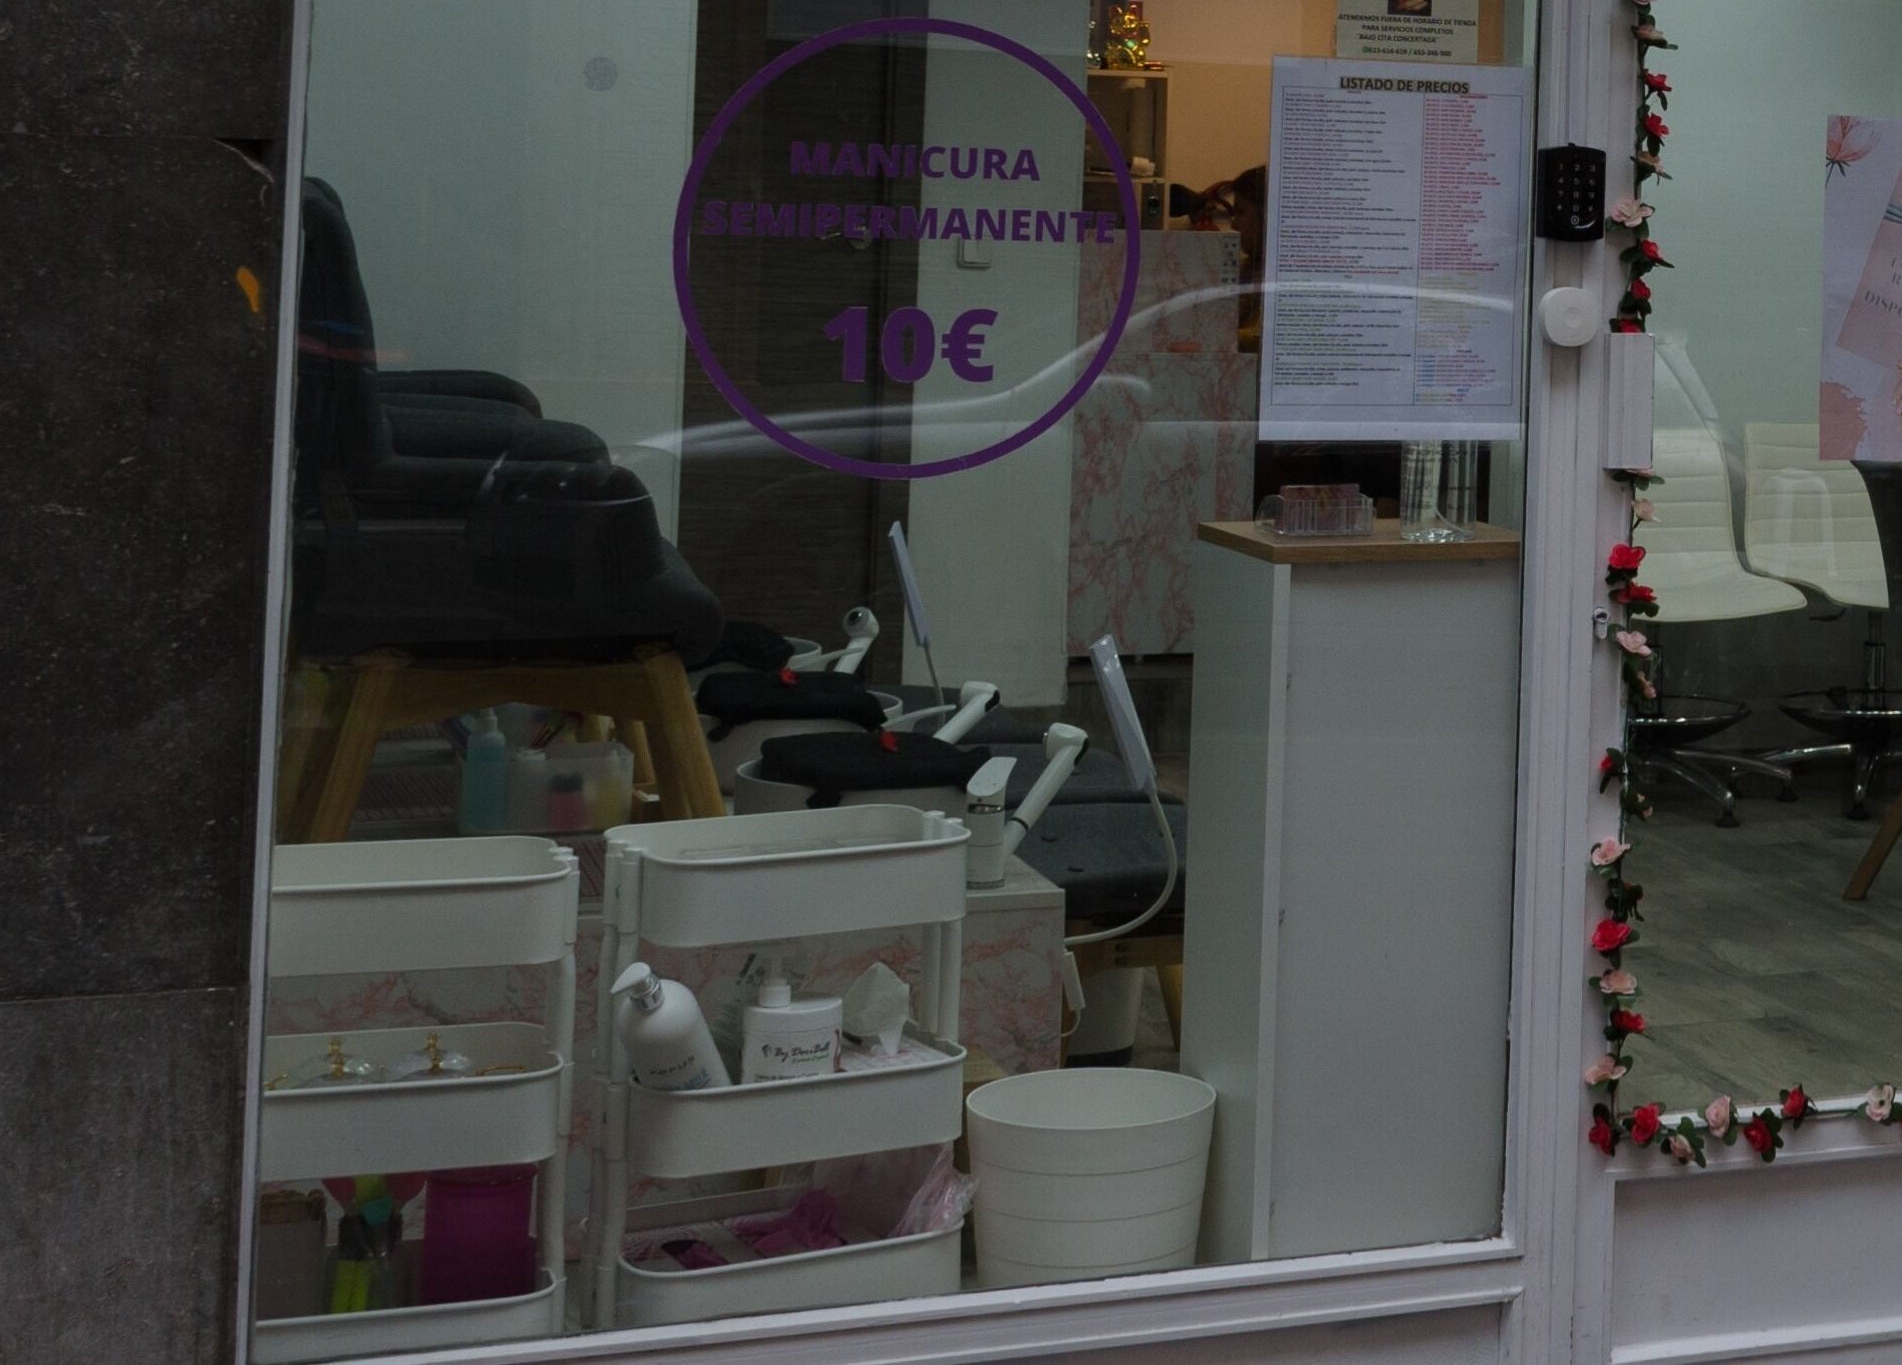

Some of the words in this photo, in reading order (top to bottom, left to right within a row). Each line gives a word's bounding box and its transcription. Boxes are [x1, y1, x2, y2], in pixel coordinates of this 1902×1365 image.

[1340, 76, 1393, 91] LISTADO
[1397, 80, 1414, 92] DE
[1416, 80, 1470, 94] PRECIOS
[789, 141, 1041, 183] MANICURA
[701, 200, 1117, 245] SEMIPERMANENTE
[821, 305, 999, 385] 10€
